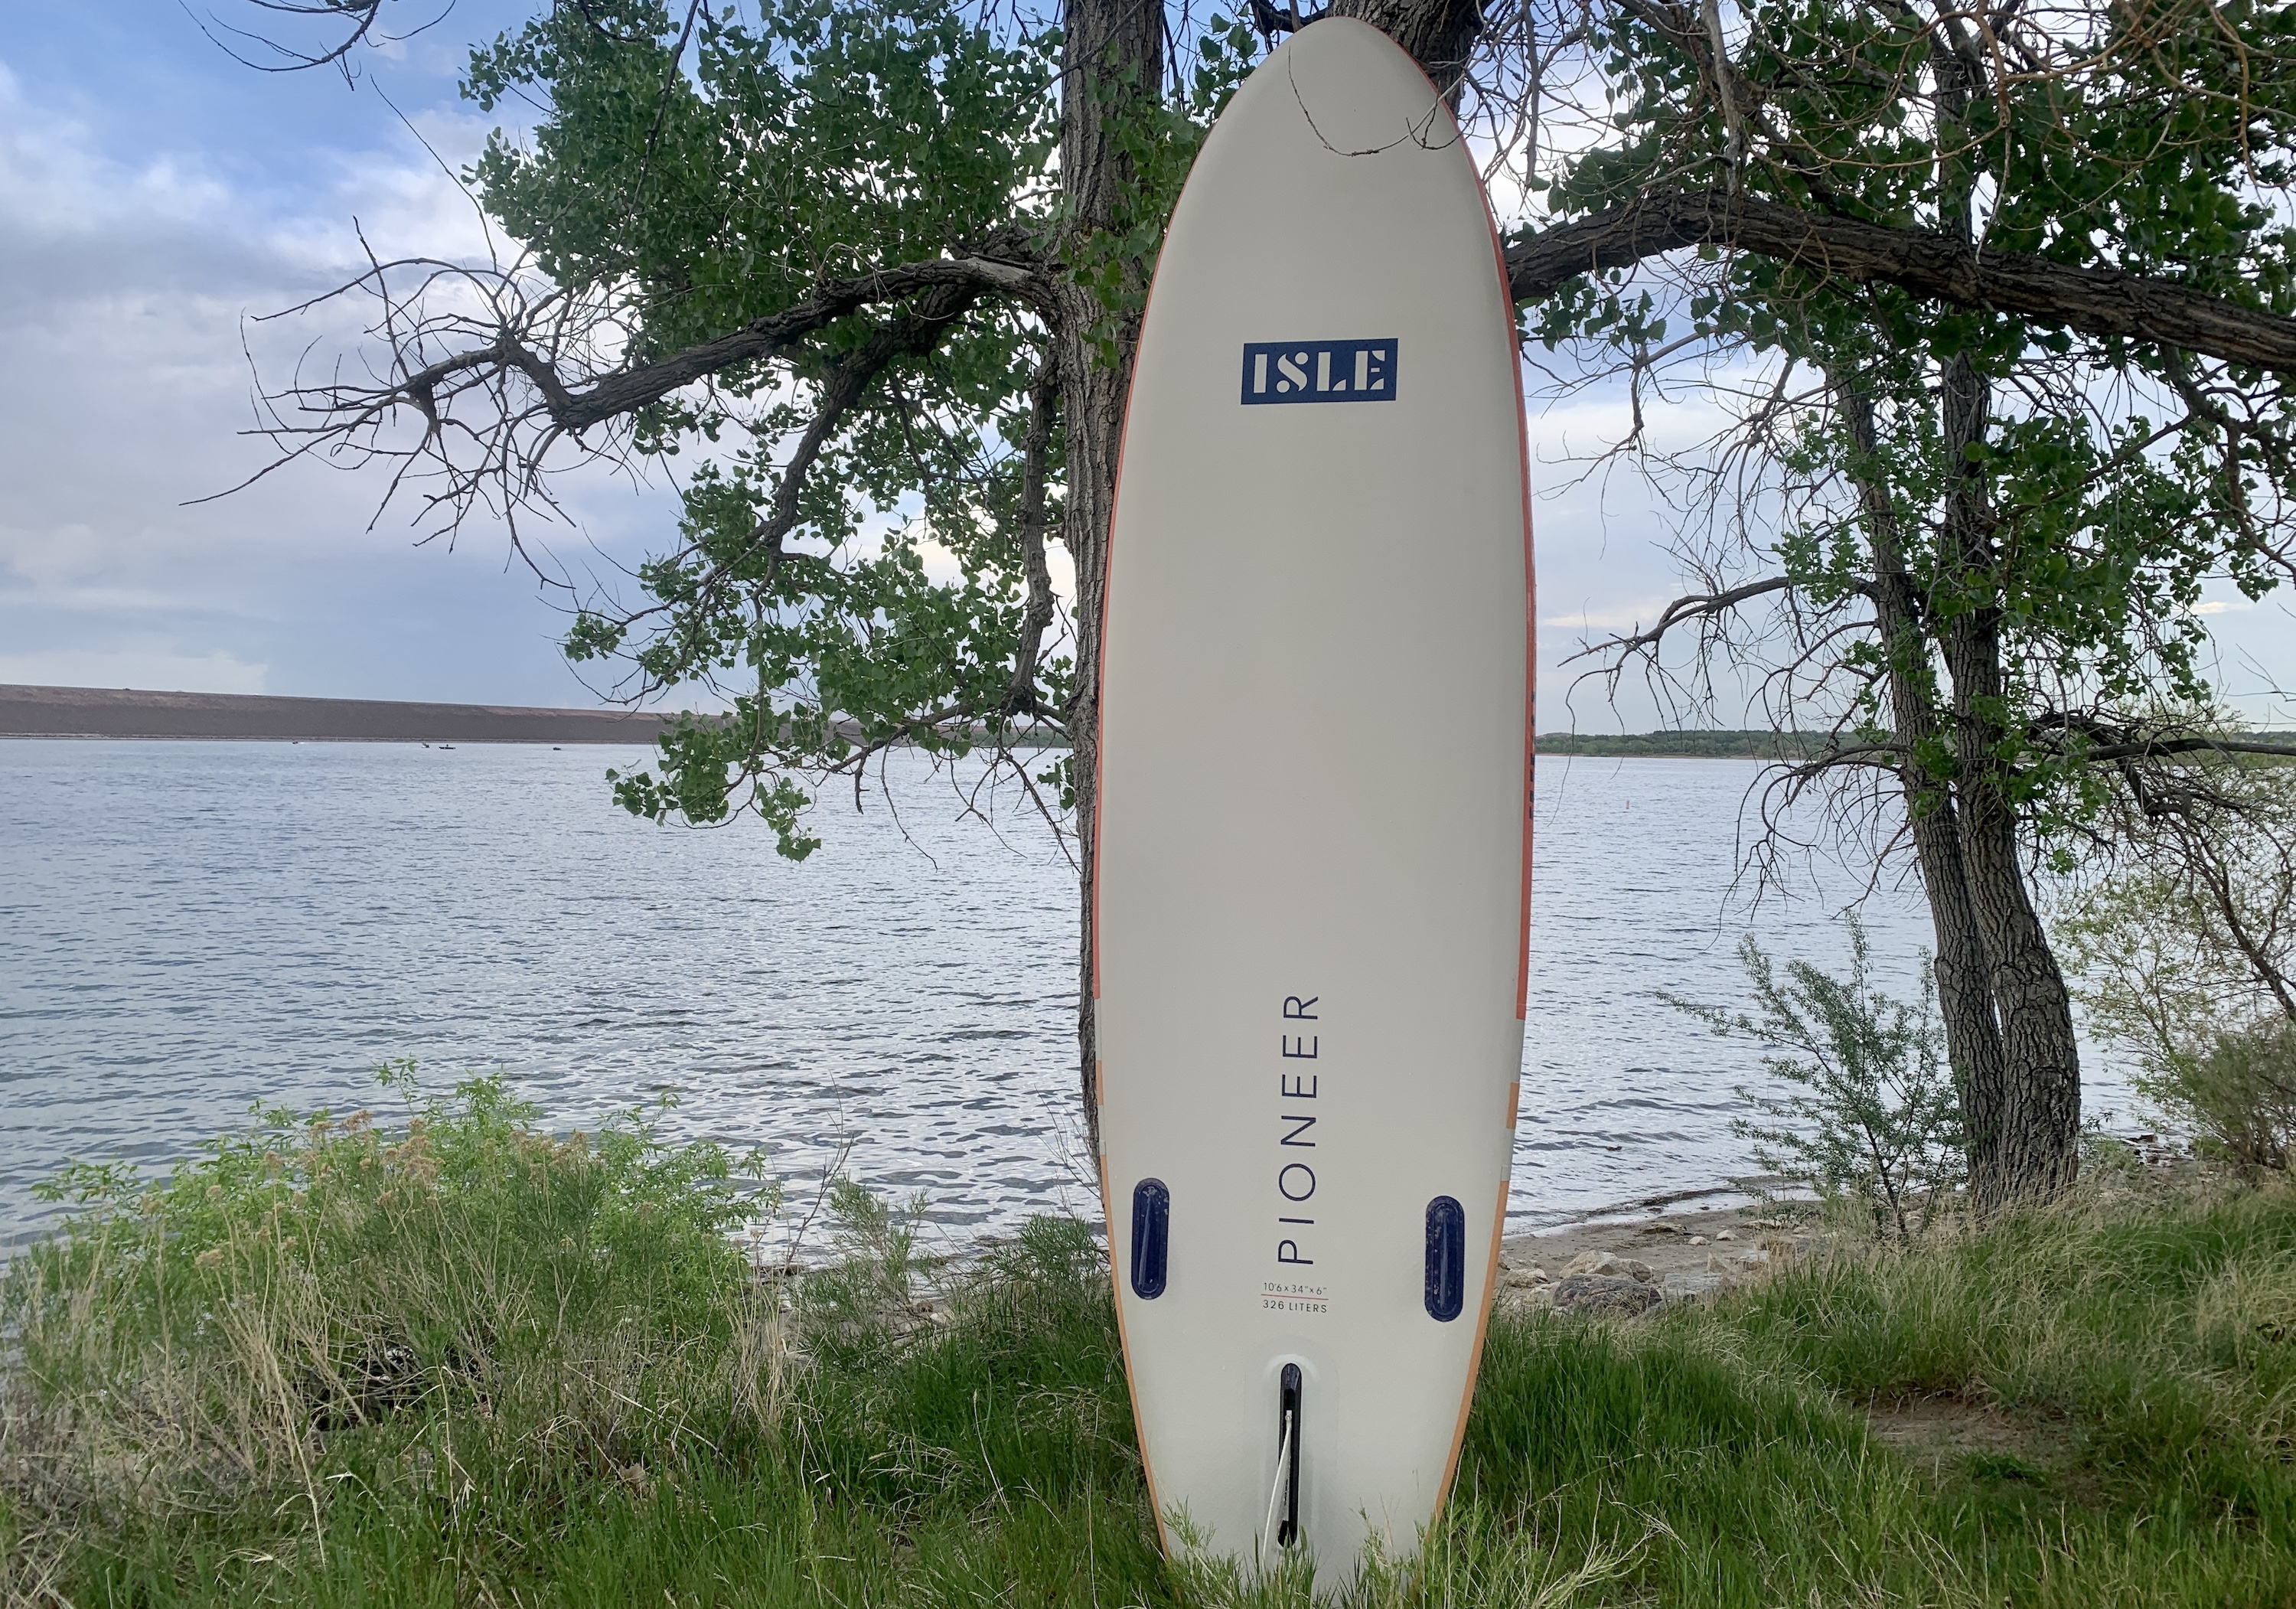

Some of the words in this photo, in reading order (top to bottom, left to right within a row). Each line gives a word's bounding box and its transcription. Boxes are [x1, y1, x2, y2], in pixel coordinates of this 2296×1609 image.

[1253, 349, 1386, 393] ISLE
[1277, 996, 1319, 1265] PIONEER
[1263, 1299, 1284, 1310] 326
[1289, 1302, 1327, 1314] LITERS
